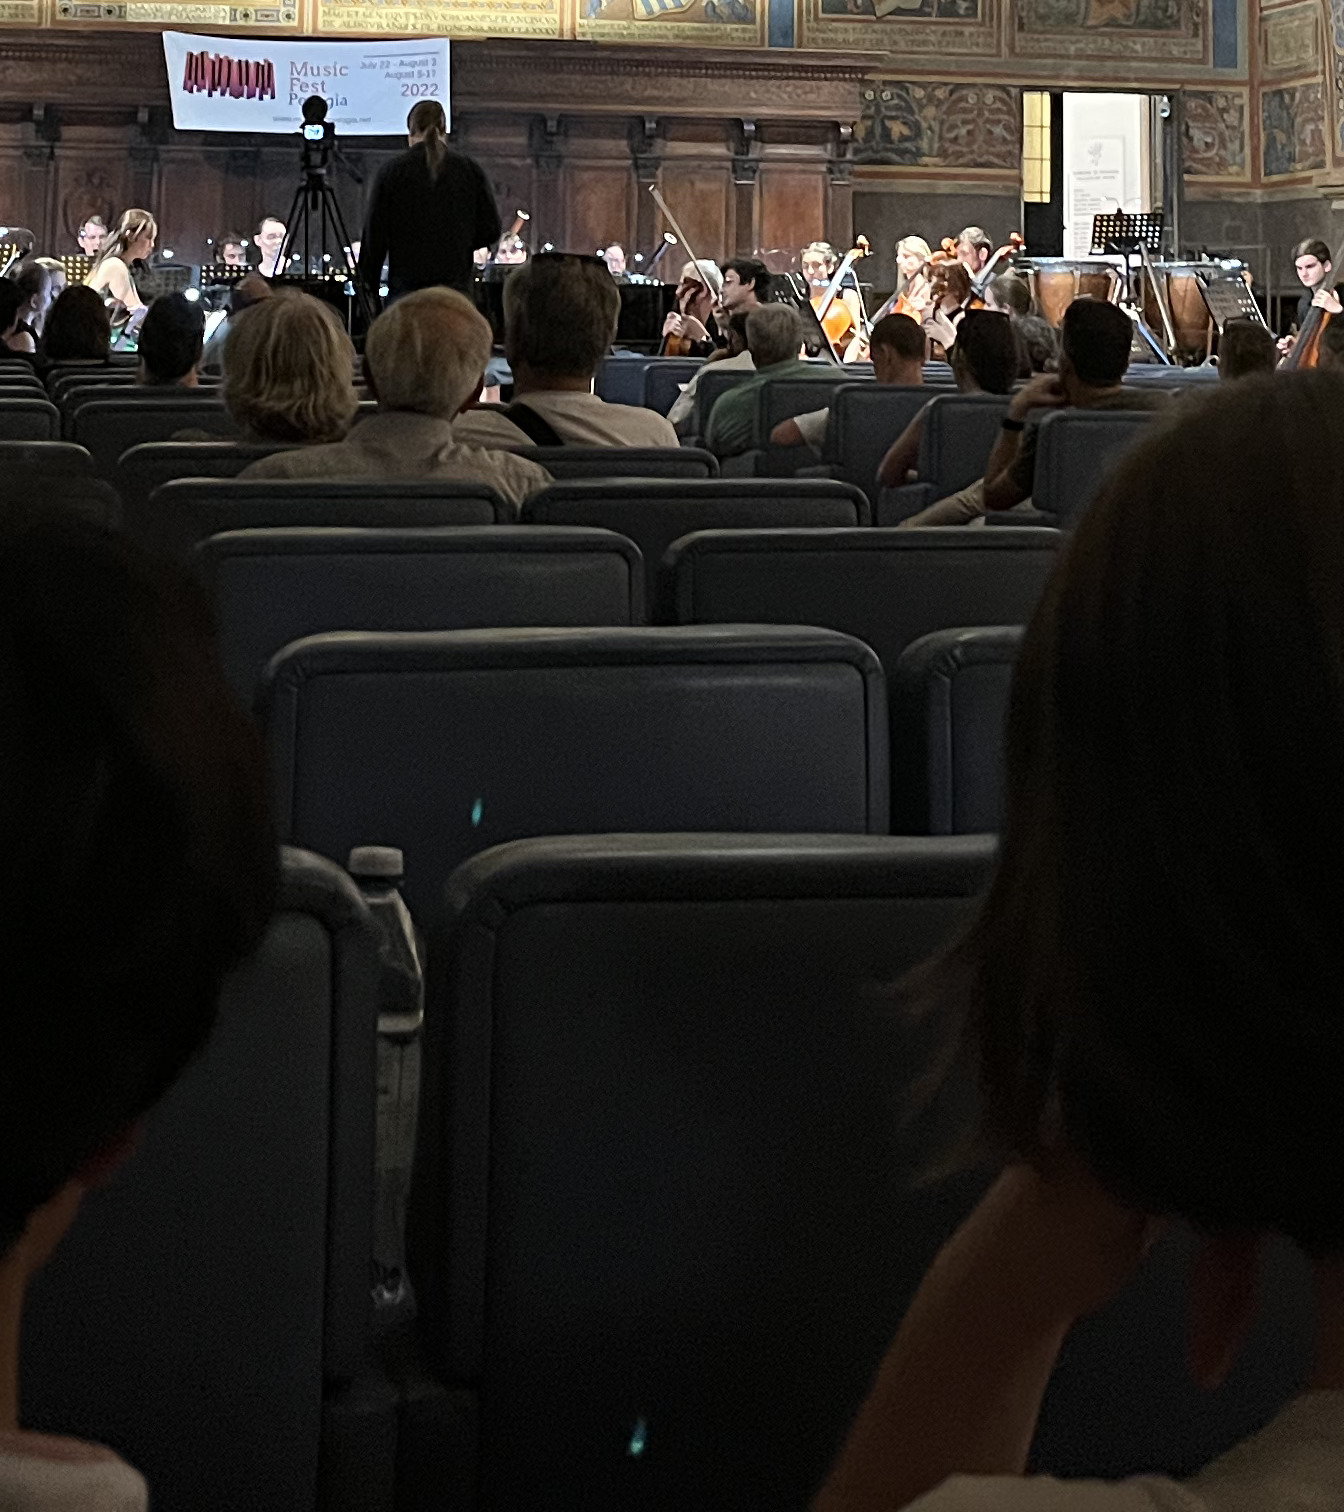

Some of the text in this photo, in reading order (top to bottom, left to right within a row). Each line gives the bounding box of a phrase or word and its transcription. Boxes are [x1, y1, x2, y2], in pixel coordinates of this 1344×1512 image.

[289, 61, 349, 77] Music
[360, 60, 377, 70] July
[379, 60, 391, 70] 22
[399, 58, 429, 68] August
[384, 70, 415, 80] August
[289, 77, 327, 94] Fest
[401, 83, 439, 97] 2022
